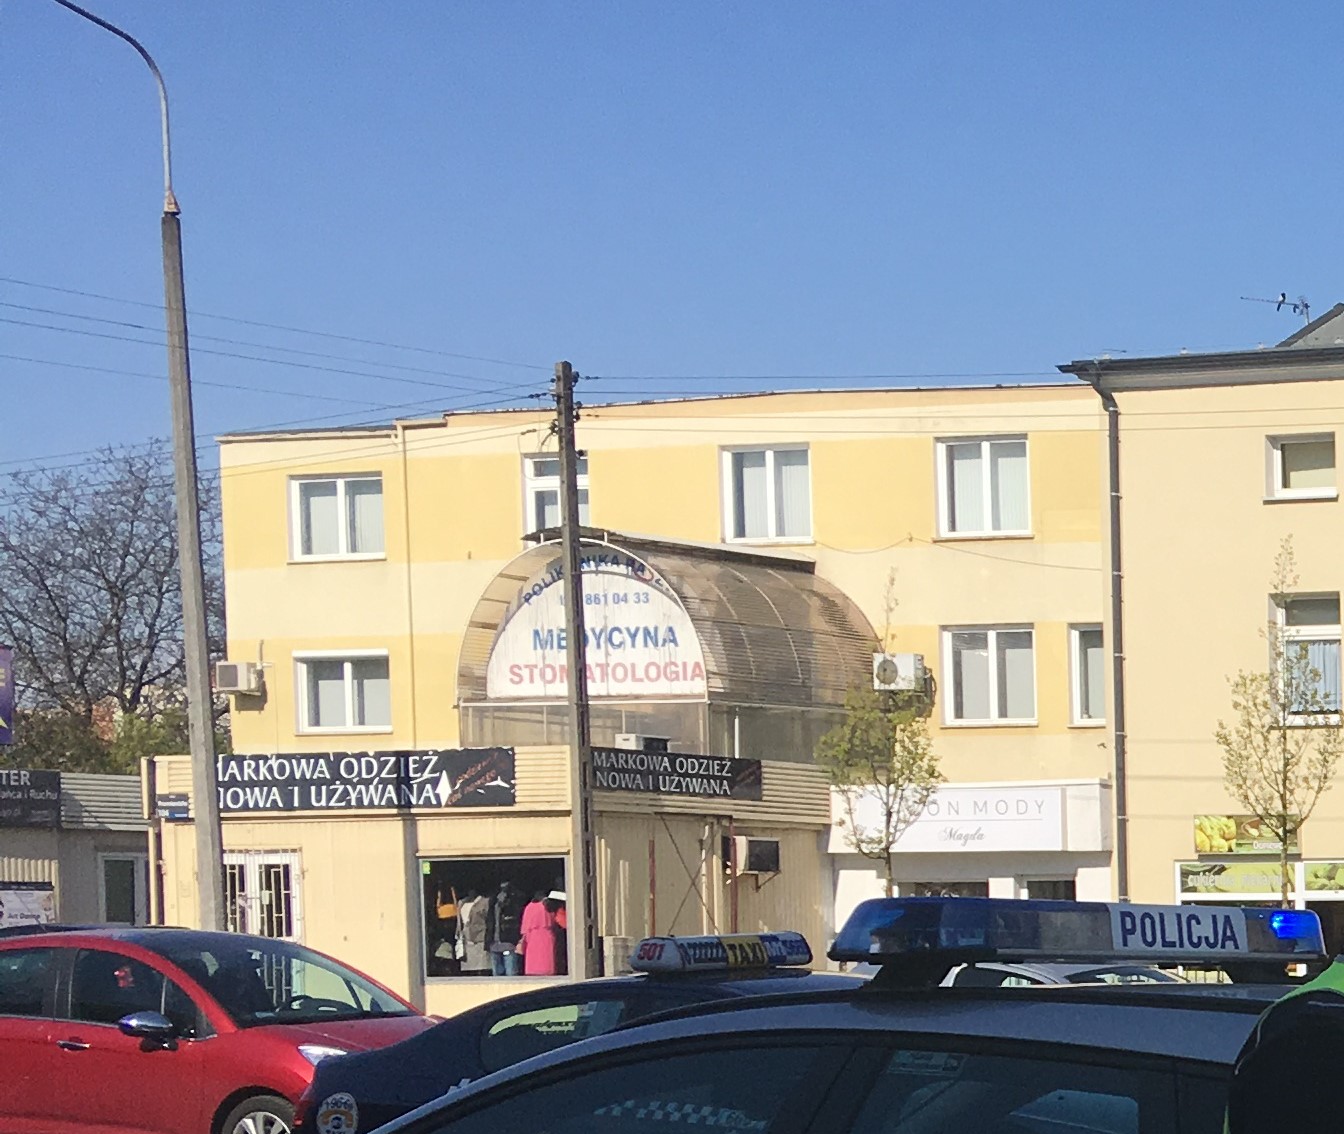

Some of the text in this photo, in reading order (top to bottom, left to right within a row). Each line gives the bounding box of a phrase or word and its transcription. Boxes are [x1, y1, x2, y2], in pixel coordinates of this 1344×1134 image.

[523, 553, 620, 605] POLIKNIKA
[612, 591, 628, 604] 04
[633, 591, 650, 604] 33
[532, 625, 679, 651] MEYCYNA
[338, 750, 440, 780] ODZIEŻ
[593, 752, 732, 777] MARKOWA ODZIEŻ
[309, 780, 438, 808] UŻYWANA
[596, 771, 643, 790] NOWA
[658, 774, 731, 796] UŻYWANA
[973, 799, 1046, 816] MODY
[940, 827, 985, 847] Magda
[1119, 910, 1240, 952] POLICJA
[637, 943, 666, 961] 501
[725, 942, 766, 967] TAXI
